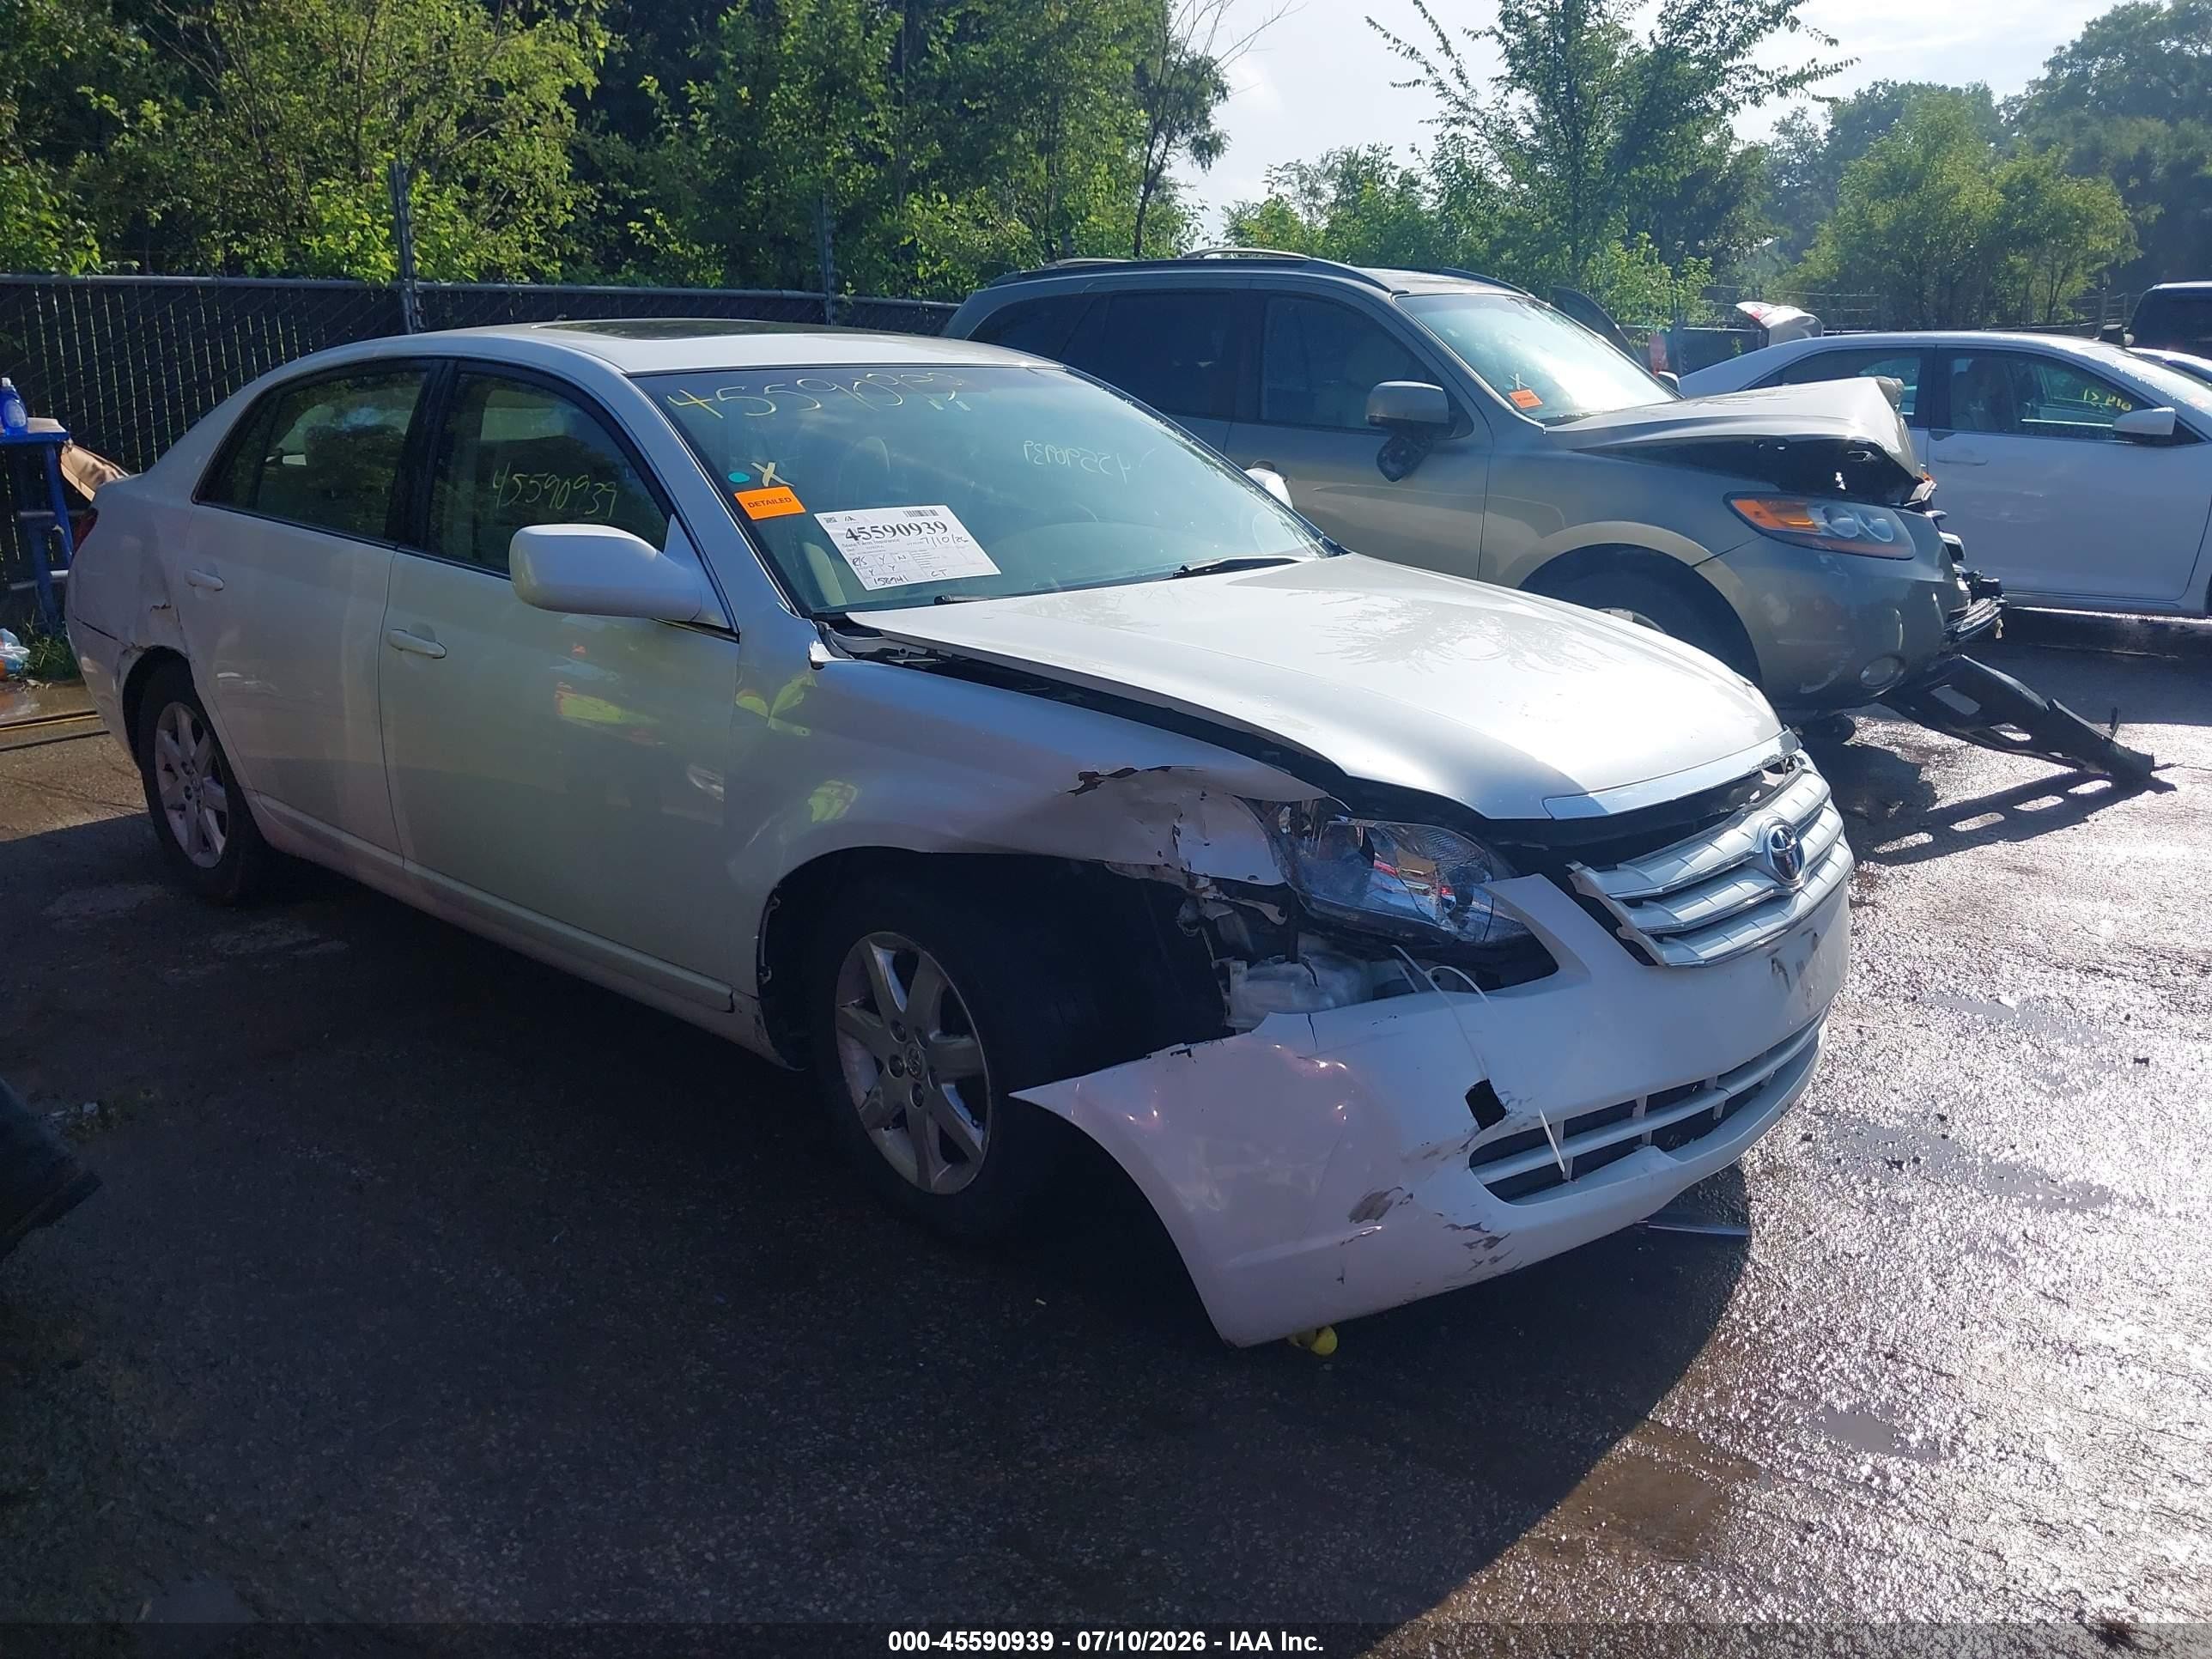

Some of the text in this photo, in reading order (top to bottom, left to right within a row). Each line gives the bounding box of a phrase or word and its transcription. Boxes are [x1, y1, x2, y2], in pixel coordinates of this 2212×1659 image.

[492, 460, 618, 520] 45590939
[747, 496, 792, 508] DETAILED
[845, 520, 948, 541] 45590939
